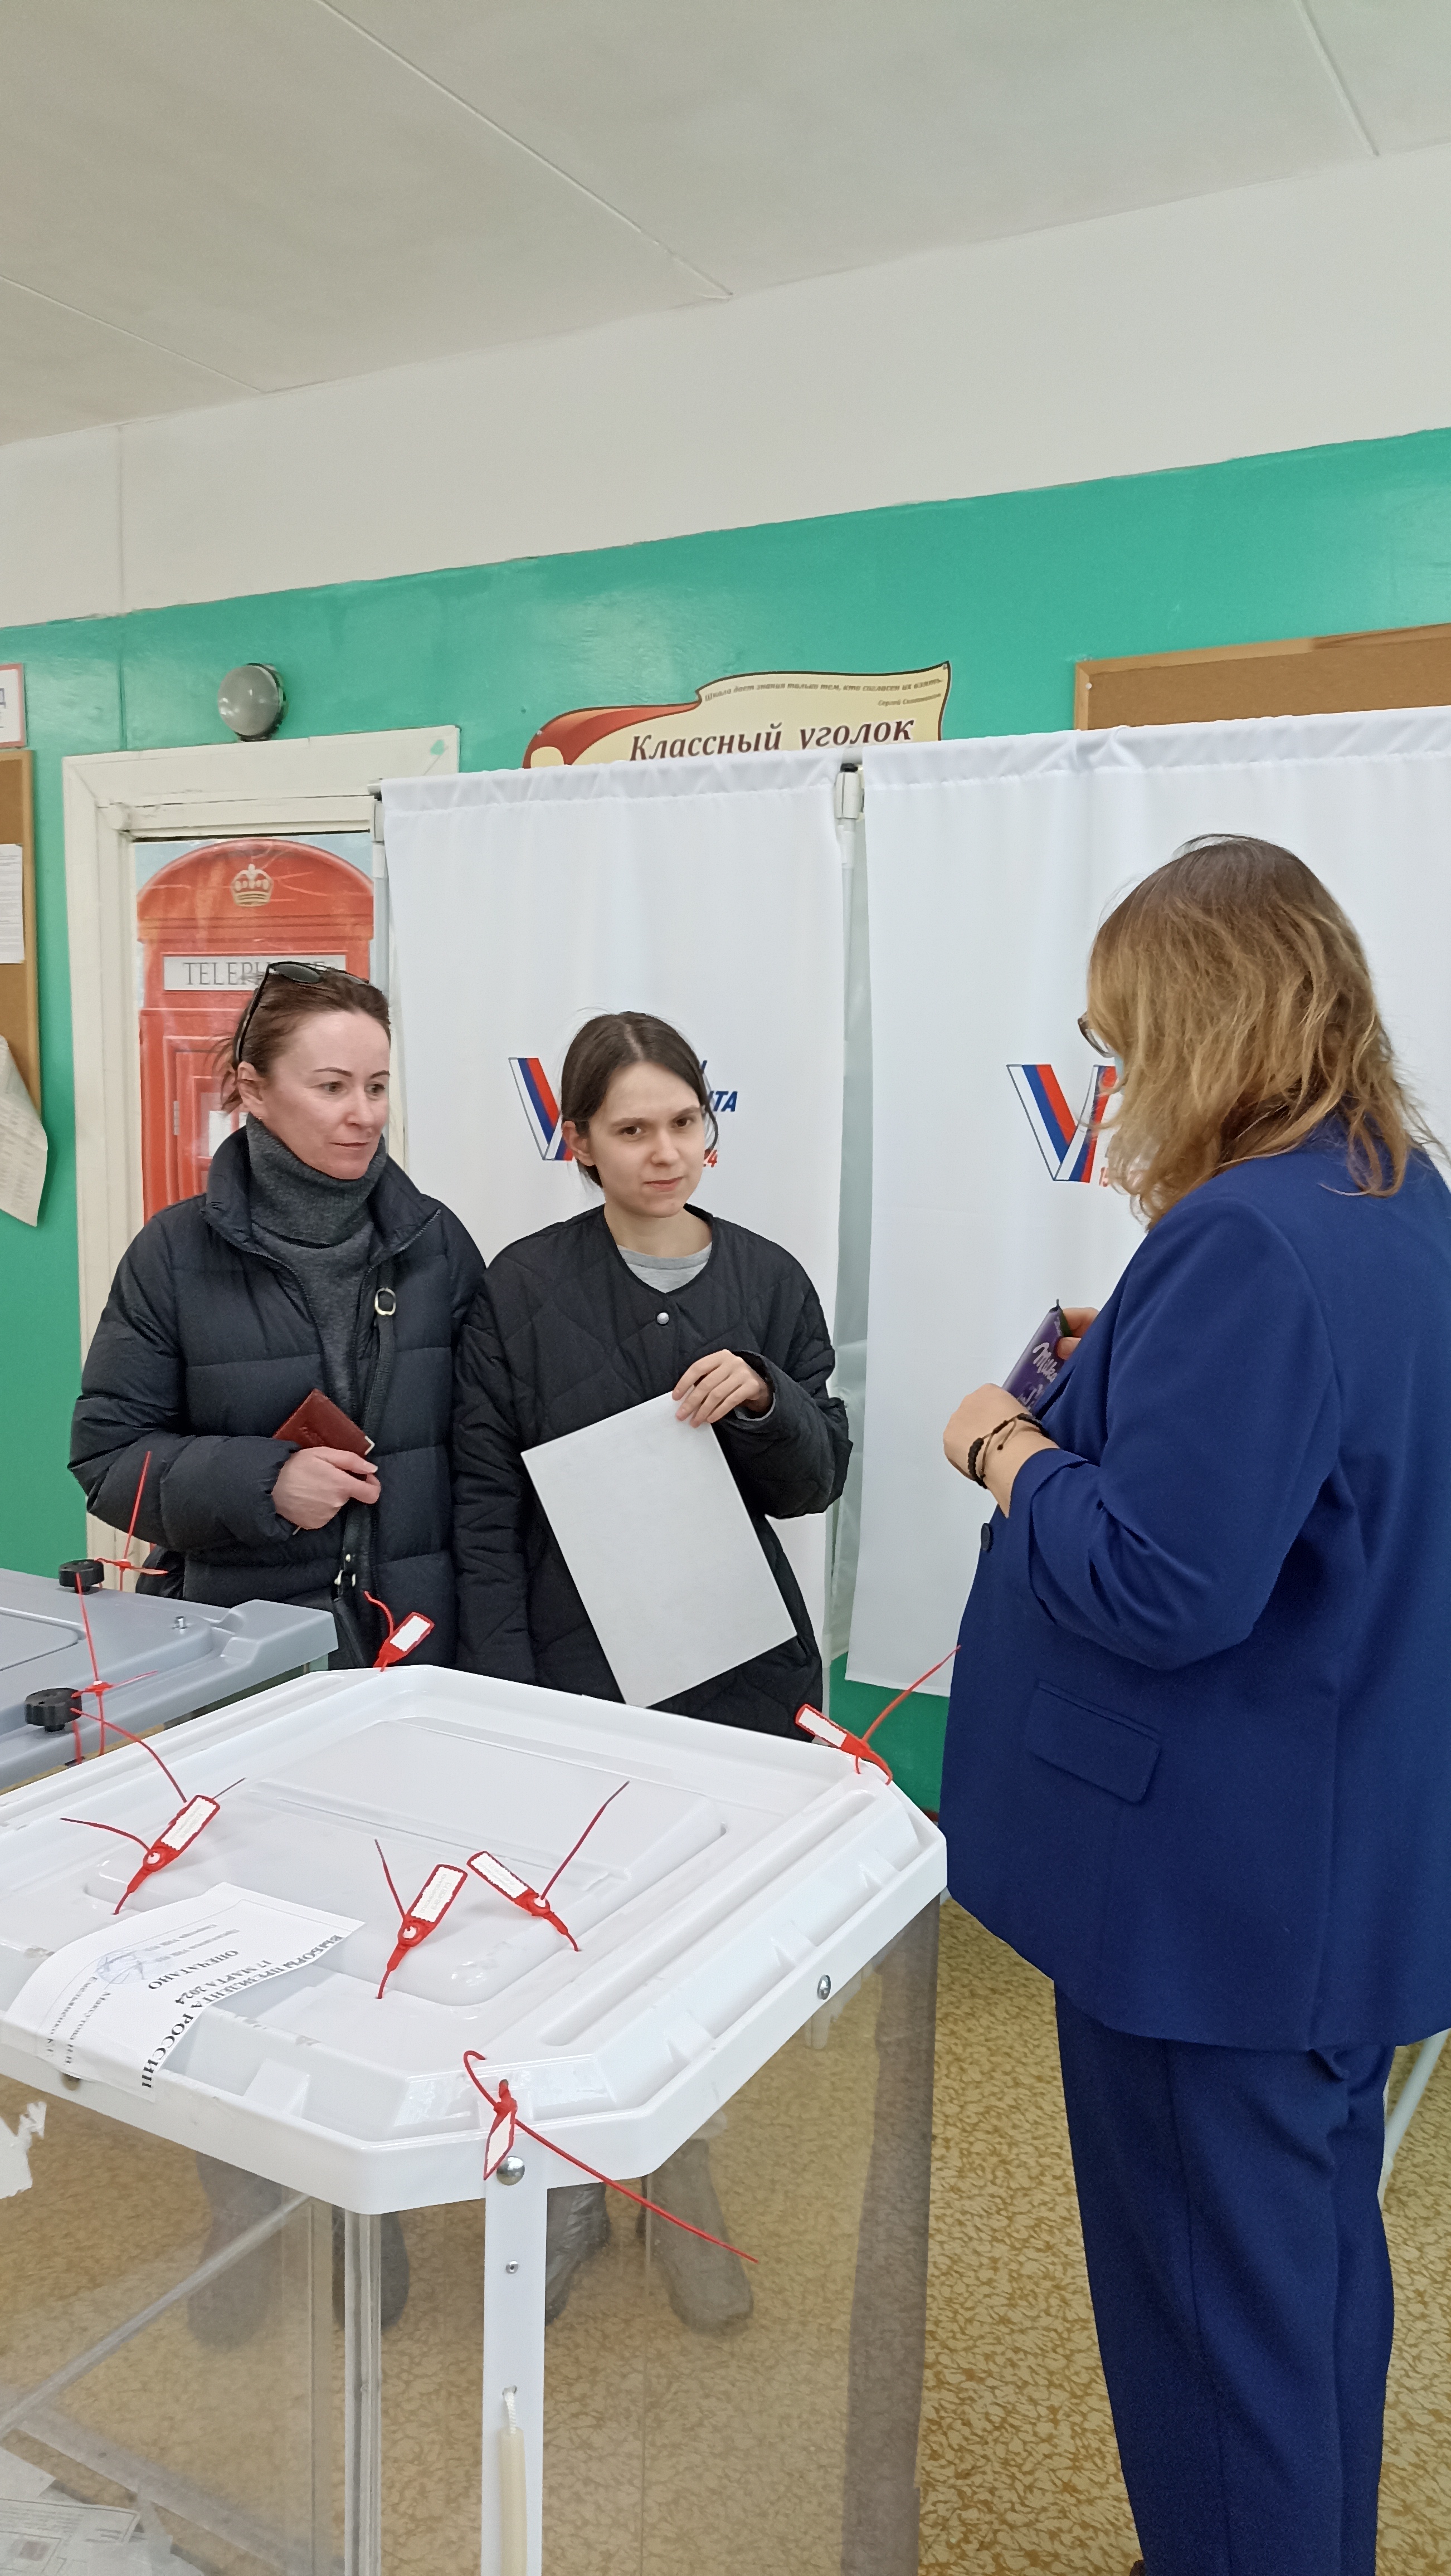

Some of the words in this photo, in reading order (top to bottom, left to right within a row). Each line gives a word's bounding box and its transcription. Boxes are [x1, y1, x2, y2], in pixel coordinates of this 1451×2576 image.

[630, 722, 782, 762] Классный
[800, 719, 914, 750] уголок
[148, 1950, 238, 1990] ОПЕЧАТАНО
[205, 1966, 259, 1987] МАРТА
[174, 1985, 207, 2006] 2024
[142, 2013, 194, 2089] РОССИИ
